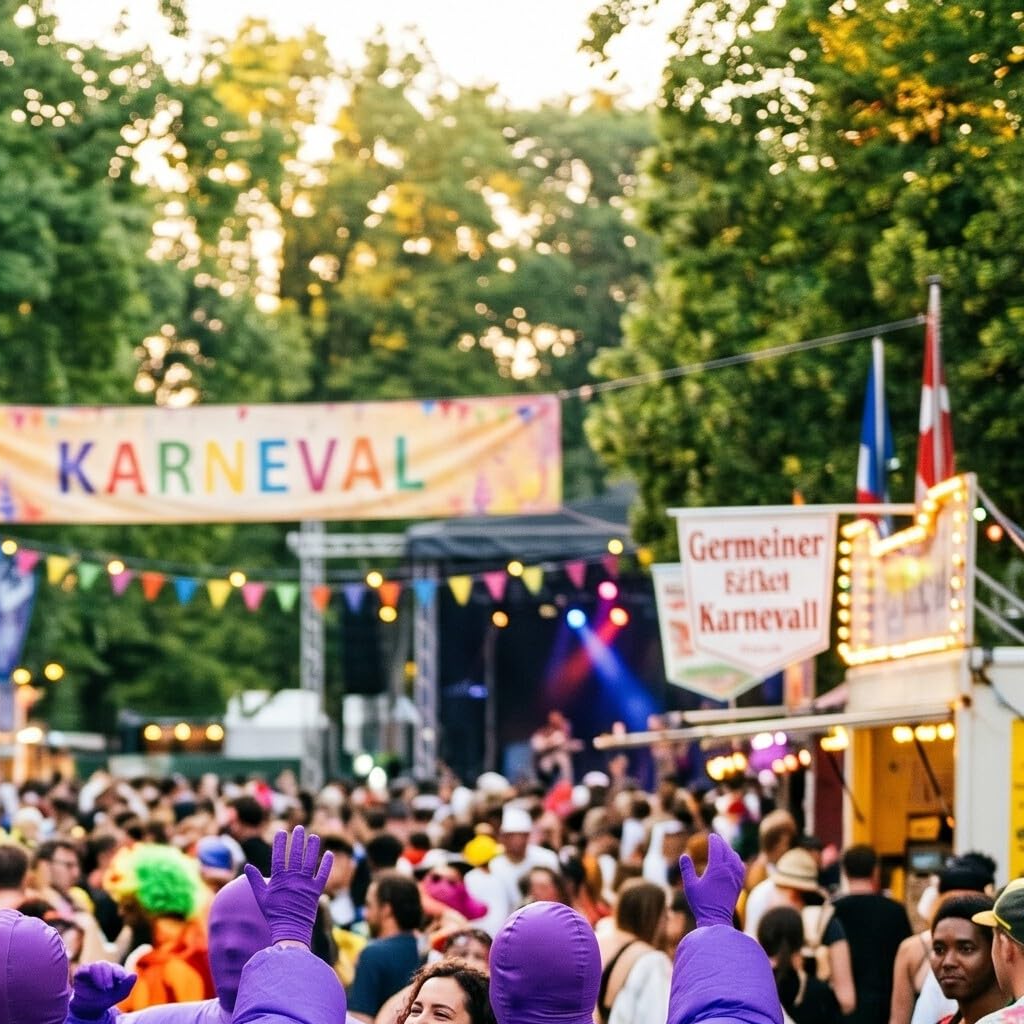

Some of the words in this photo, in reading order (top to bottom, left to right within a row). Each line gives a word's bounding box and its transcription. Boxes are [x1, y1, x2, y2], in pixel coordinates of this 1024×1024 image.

[58, 436, 426, 494] KARNEVAL
[688, 526, 825, 561] Germeiner
[697, 598, 820, 634] Karnevall
